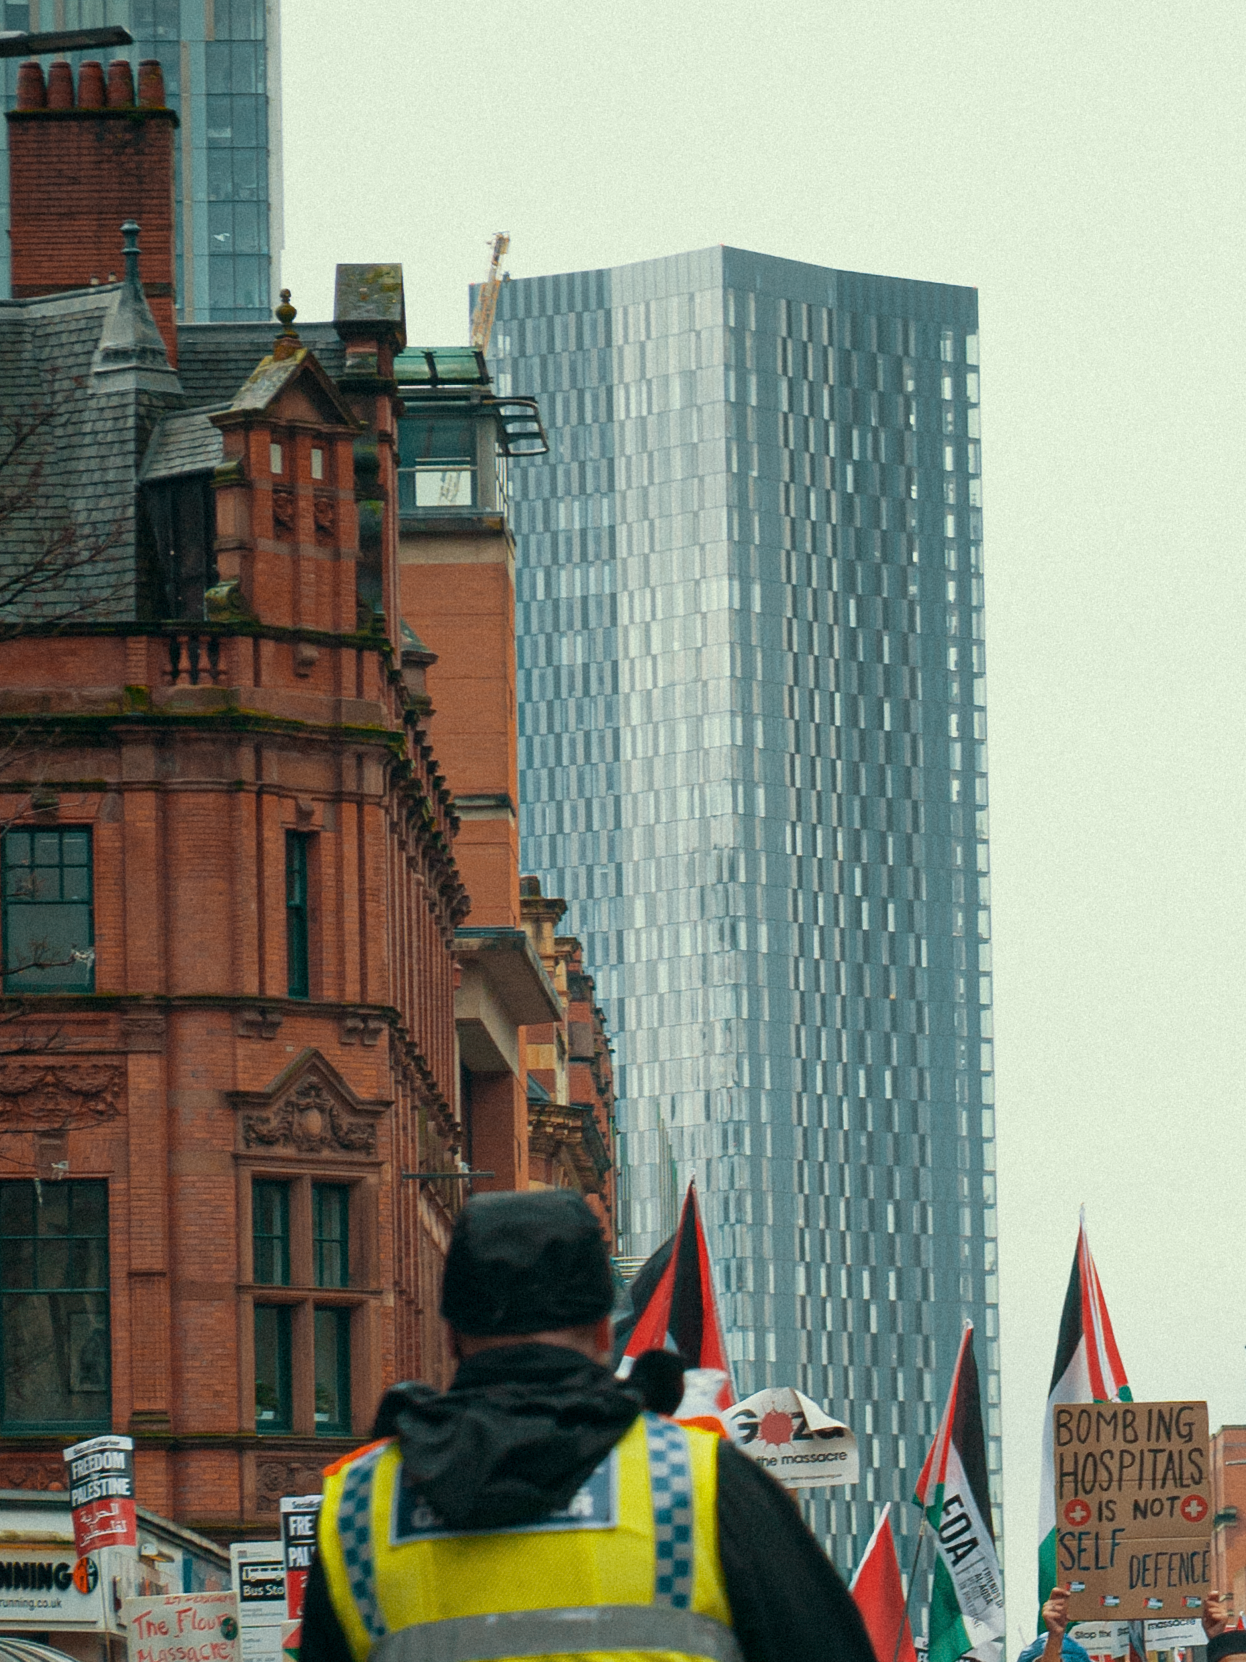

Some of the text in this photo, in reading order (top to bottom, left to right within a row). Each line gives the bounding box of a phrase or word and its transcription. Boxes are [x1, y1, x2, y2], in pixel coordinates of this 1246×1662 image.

[1056, 1406, 1195, 1446] BOMBING
[72, 1452, 126, 1480] FREEDOM
[781, 1451, 848, 1465] massacre
[1059, 1447, 1204, 1499] HOSPITALS
[71, 1478, 131, 1507] PALESTINE
[1098, 1496, 1180, 1522] IS NOT
[938, 1494, 980, 1567] FOA
[243, 1584, 286, 1597] Bus Sto
[132, 1607, 230, 1640] The Flour
[1074, 1630, 1097, 1641] Stop
